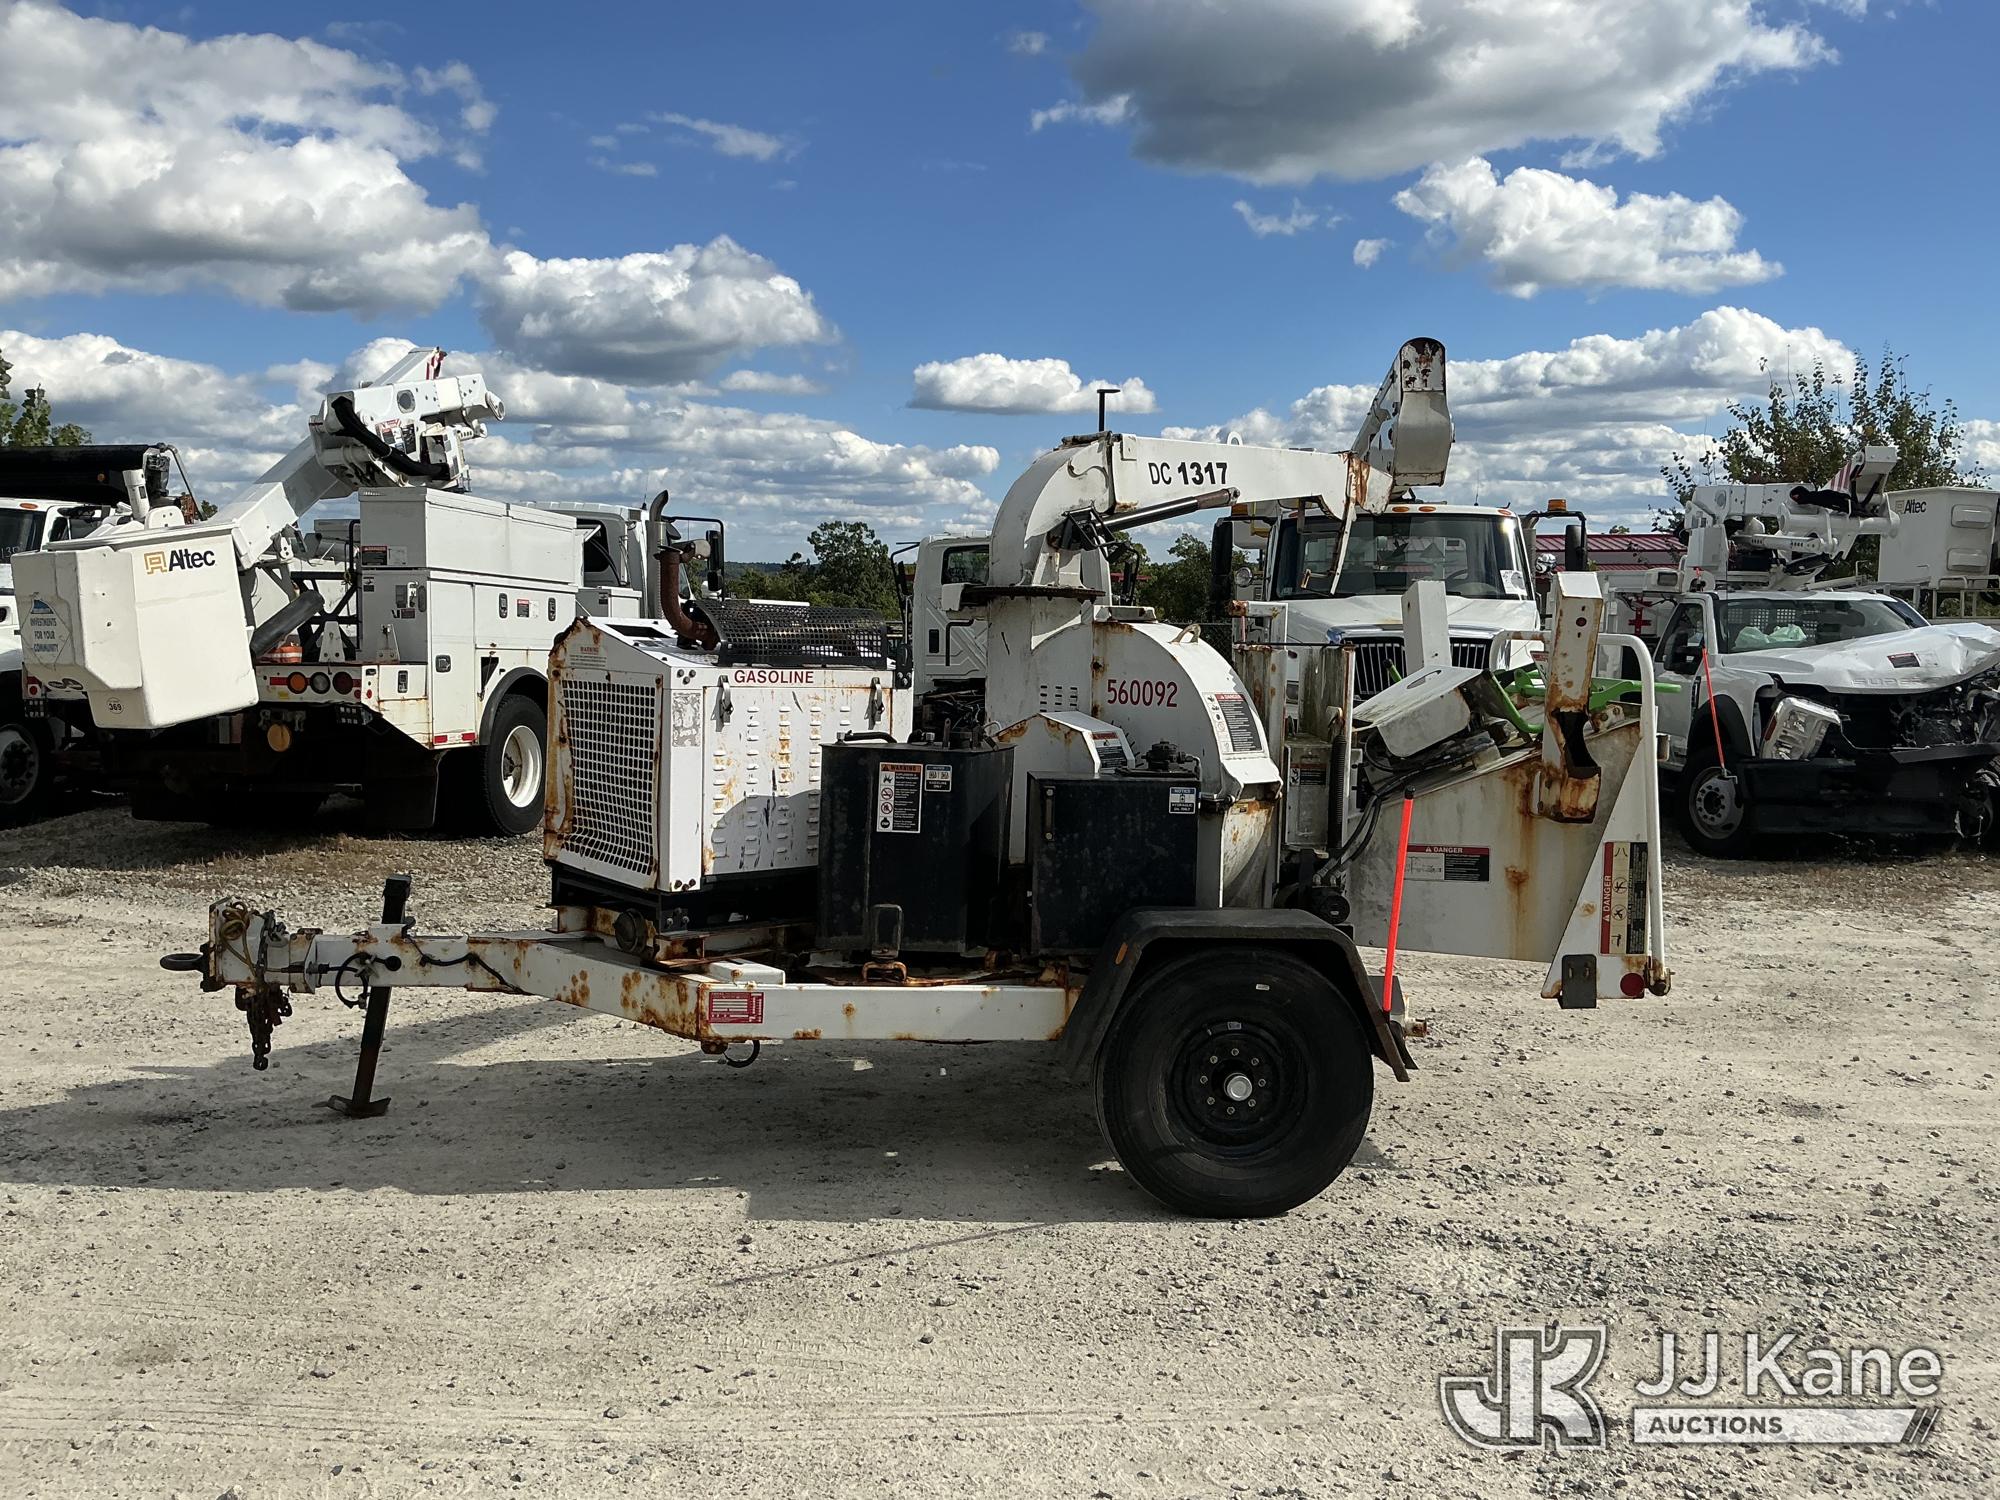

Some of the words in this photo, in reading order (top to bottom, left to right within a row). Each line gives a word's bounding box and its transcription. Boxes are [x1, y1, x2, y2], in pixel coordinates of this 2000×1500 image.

[1148, 462, 1172, 485] DC
[1177, 462, 1227, 485] 1317
[1903, 499, 1927, 514] Altec
[168, 548, 216, 572] Altec
[34, 630, 43, 640] FOR
[43, 630, 55, 640] YOUR
[734, 669, 814, 684] GASOLINE
[1107, 679, 1178, 708] 560092
[108, 703, 122, 711] 369
[1433, 846, 1463, 854] DANGER
[1603, 875, 1612, 912] DANGER
